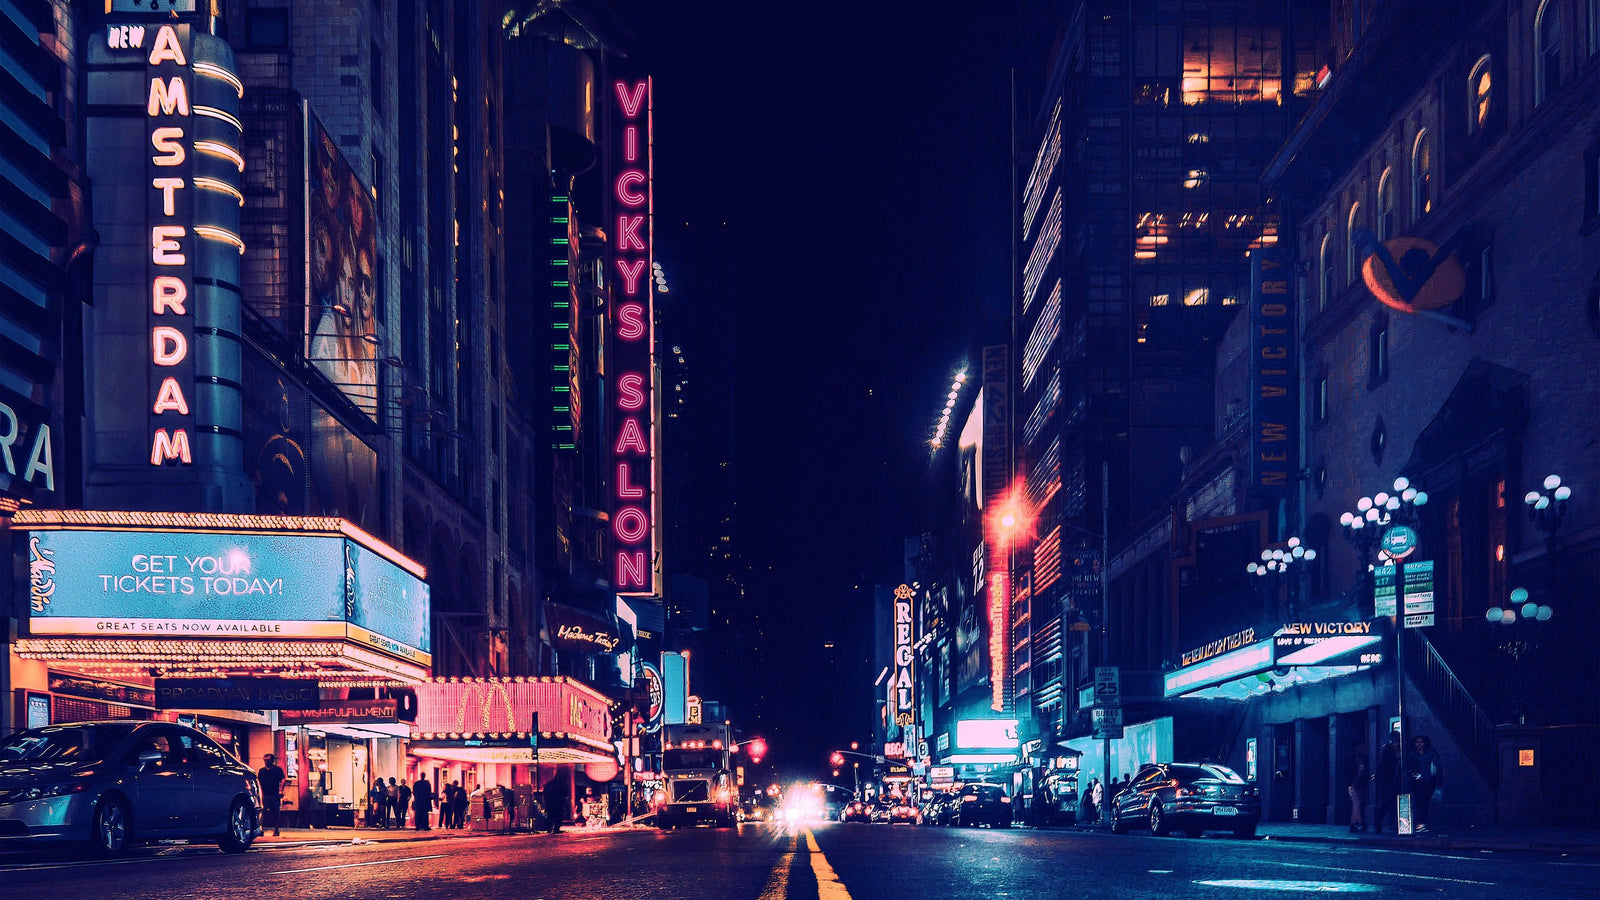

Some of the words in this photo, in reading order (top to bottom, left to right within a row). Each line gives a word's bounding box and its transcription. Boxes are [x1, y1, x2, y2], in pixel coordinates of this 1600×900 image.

[108, 24, 146, 49] NEW
[616, 82, 646, 338] VICKYS
[148, 24, 192, 466] AMSTERDAM
[1261, 258, 1288, 398] VICTORY
[1261, 421, 1288, 486] NEW
[616, 374, 647, 586] SALON
[131, 554, 177, 573] GET
[184, 555, 251, 575] YOUR
[98, 574, 195, 595] TICKETS
[200, 576, 283, 596] TODAY!
[96, 621, 136, 631] GREAT
[141, 622, 178, 632] SEATS
[182, 623, 211, 632] NOW
[216, 623, 281, 633] AVAILABLE
[557, 624, 594, 642] Madame
[1283, 622, 1312, 635] NEW
[1314, 621, 1372, 635] VICTORY
[895, 601, 915, 710] REGAL
[160, 688, 253, 701] BROADWAY
[1096, 682, 1118, 696] 25
[1098, 716, 1117, 725] ONLY
